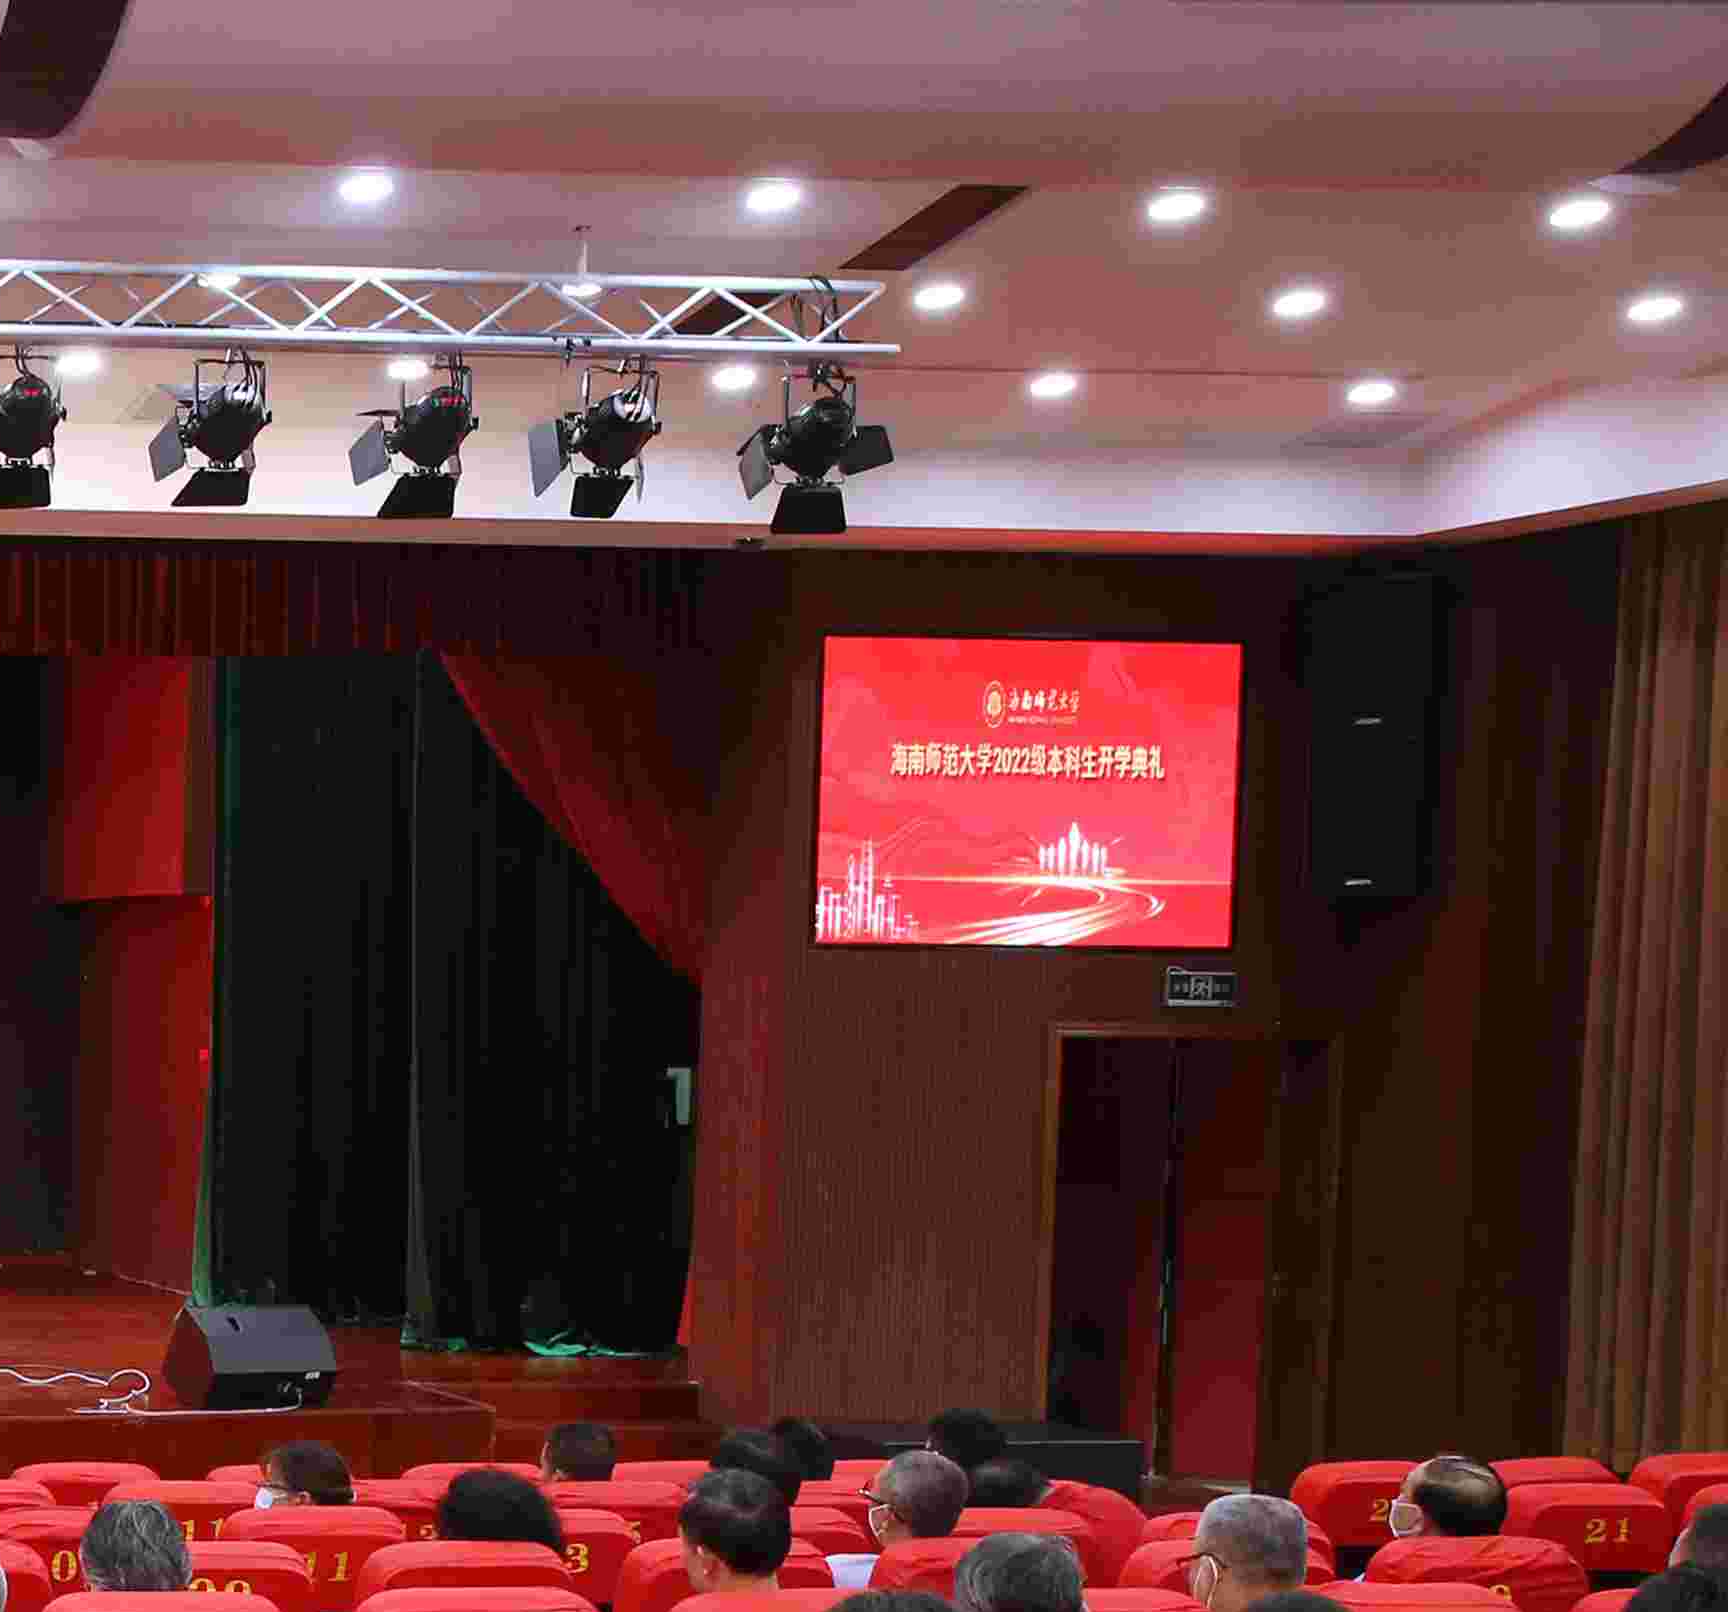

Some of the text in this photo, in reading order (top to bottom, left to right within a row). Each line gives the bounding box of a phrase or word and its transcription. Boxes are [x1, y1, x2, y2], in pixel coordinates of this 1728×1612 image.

[889, 742, 1166, 780] 海南师范大学2022级本科生开学典礼
[1583, 1518, 1632, 1544] 21
[562, 1543, 589, 1574] 3
